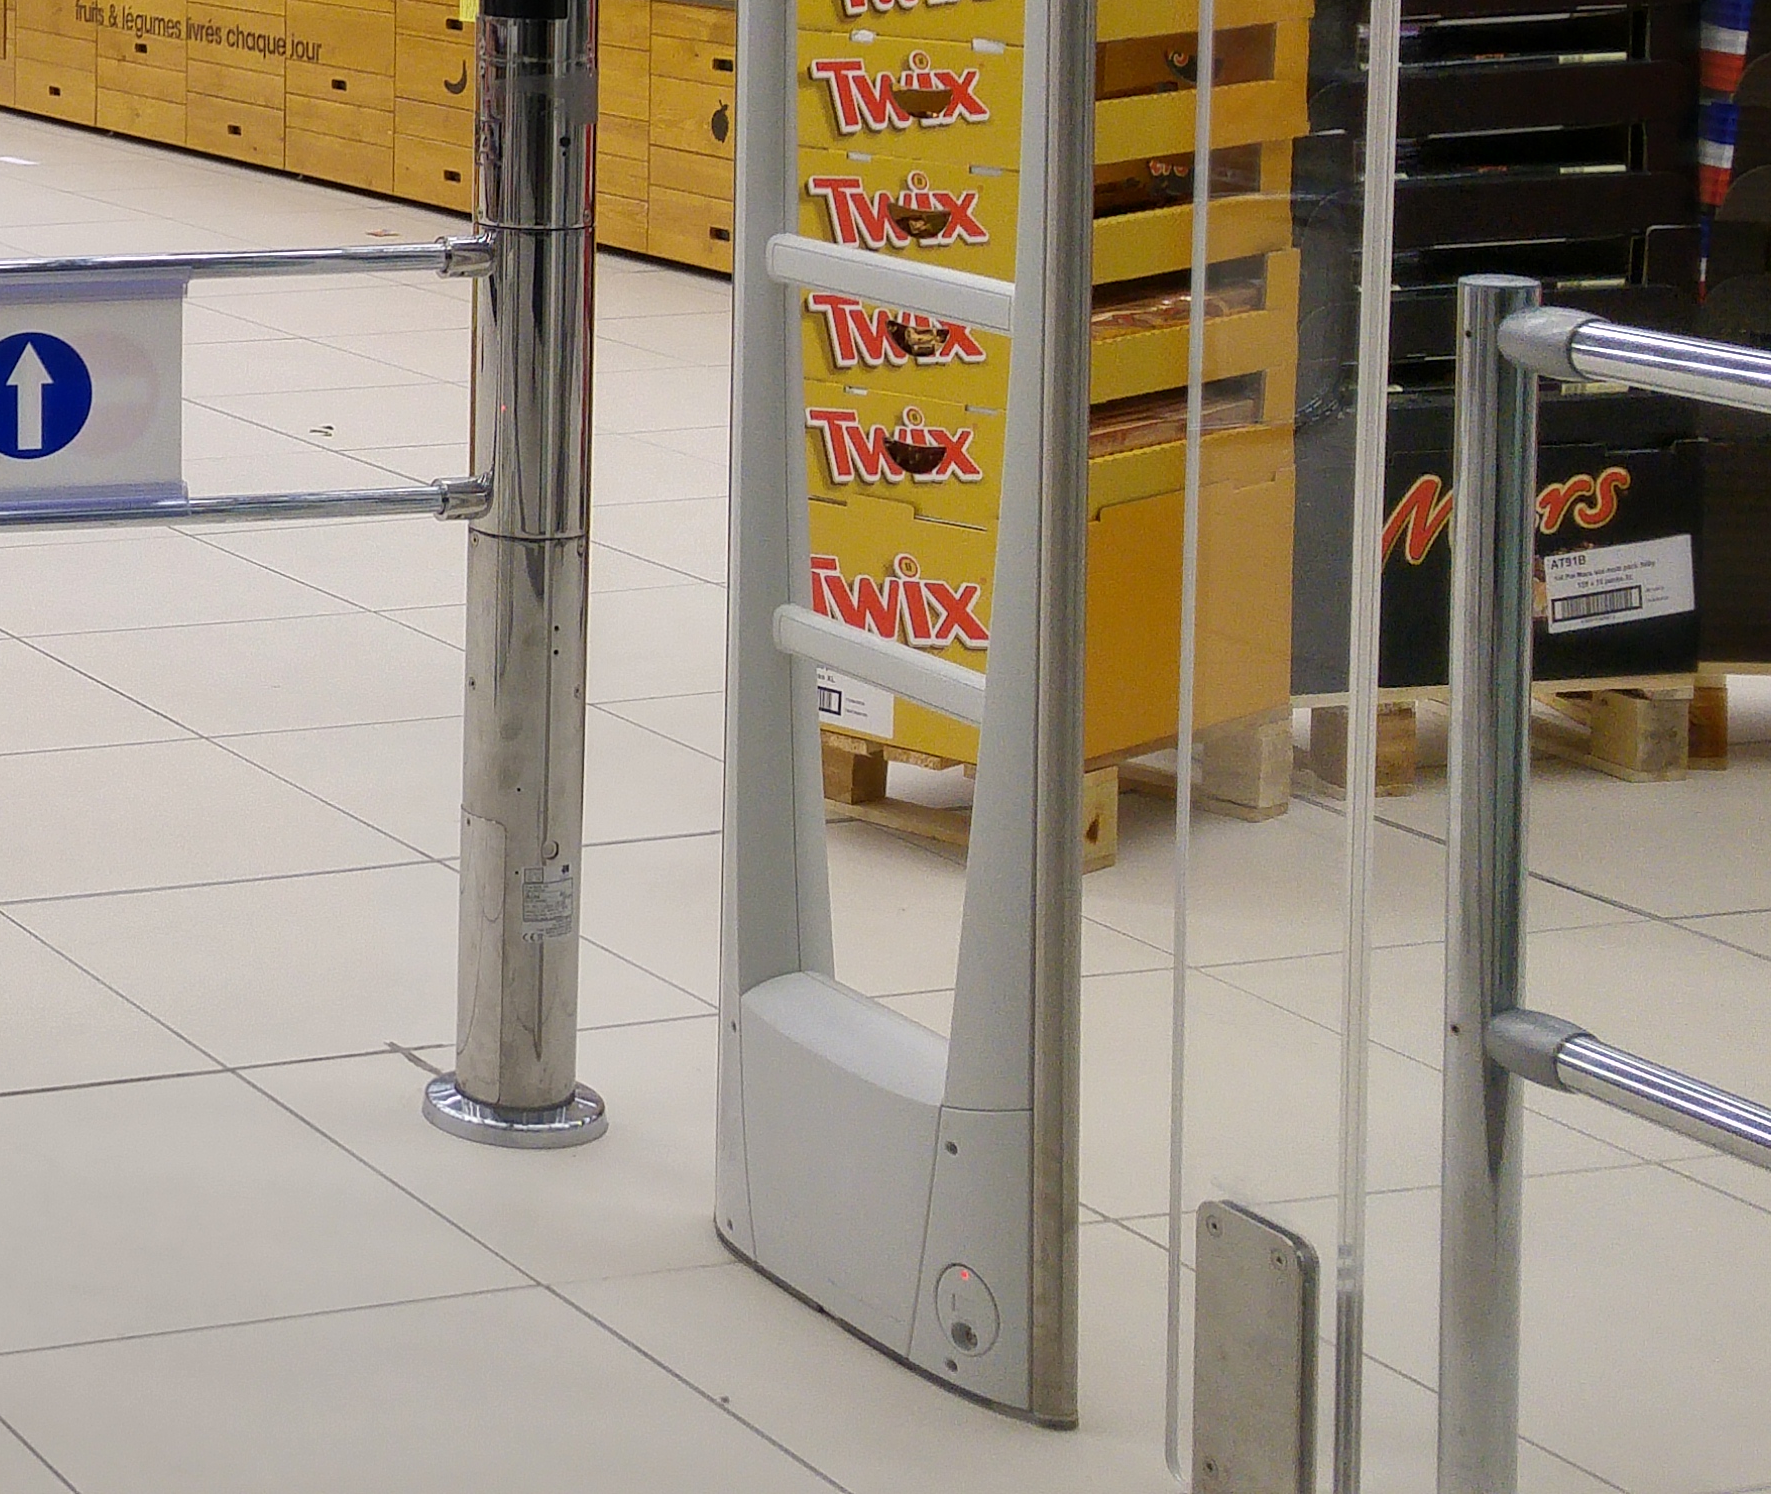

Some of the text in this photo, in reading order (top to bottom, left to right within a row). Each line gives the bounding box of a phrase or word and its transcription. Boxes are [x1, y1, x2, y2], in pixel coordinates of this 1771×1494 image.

[75, 0, 322, 62] fruits & légumes livrés chaque jour
[1381, 466, 1632, 566] Mrs
[1550, 555, 1587, 570] AT91B
